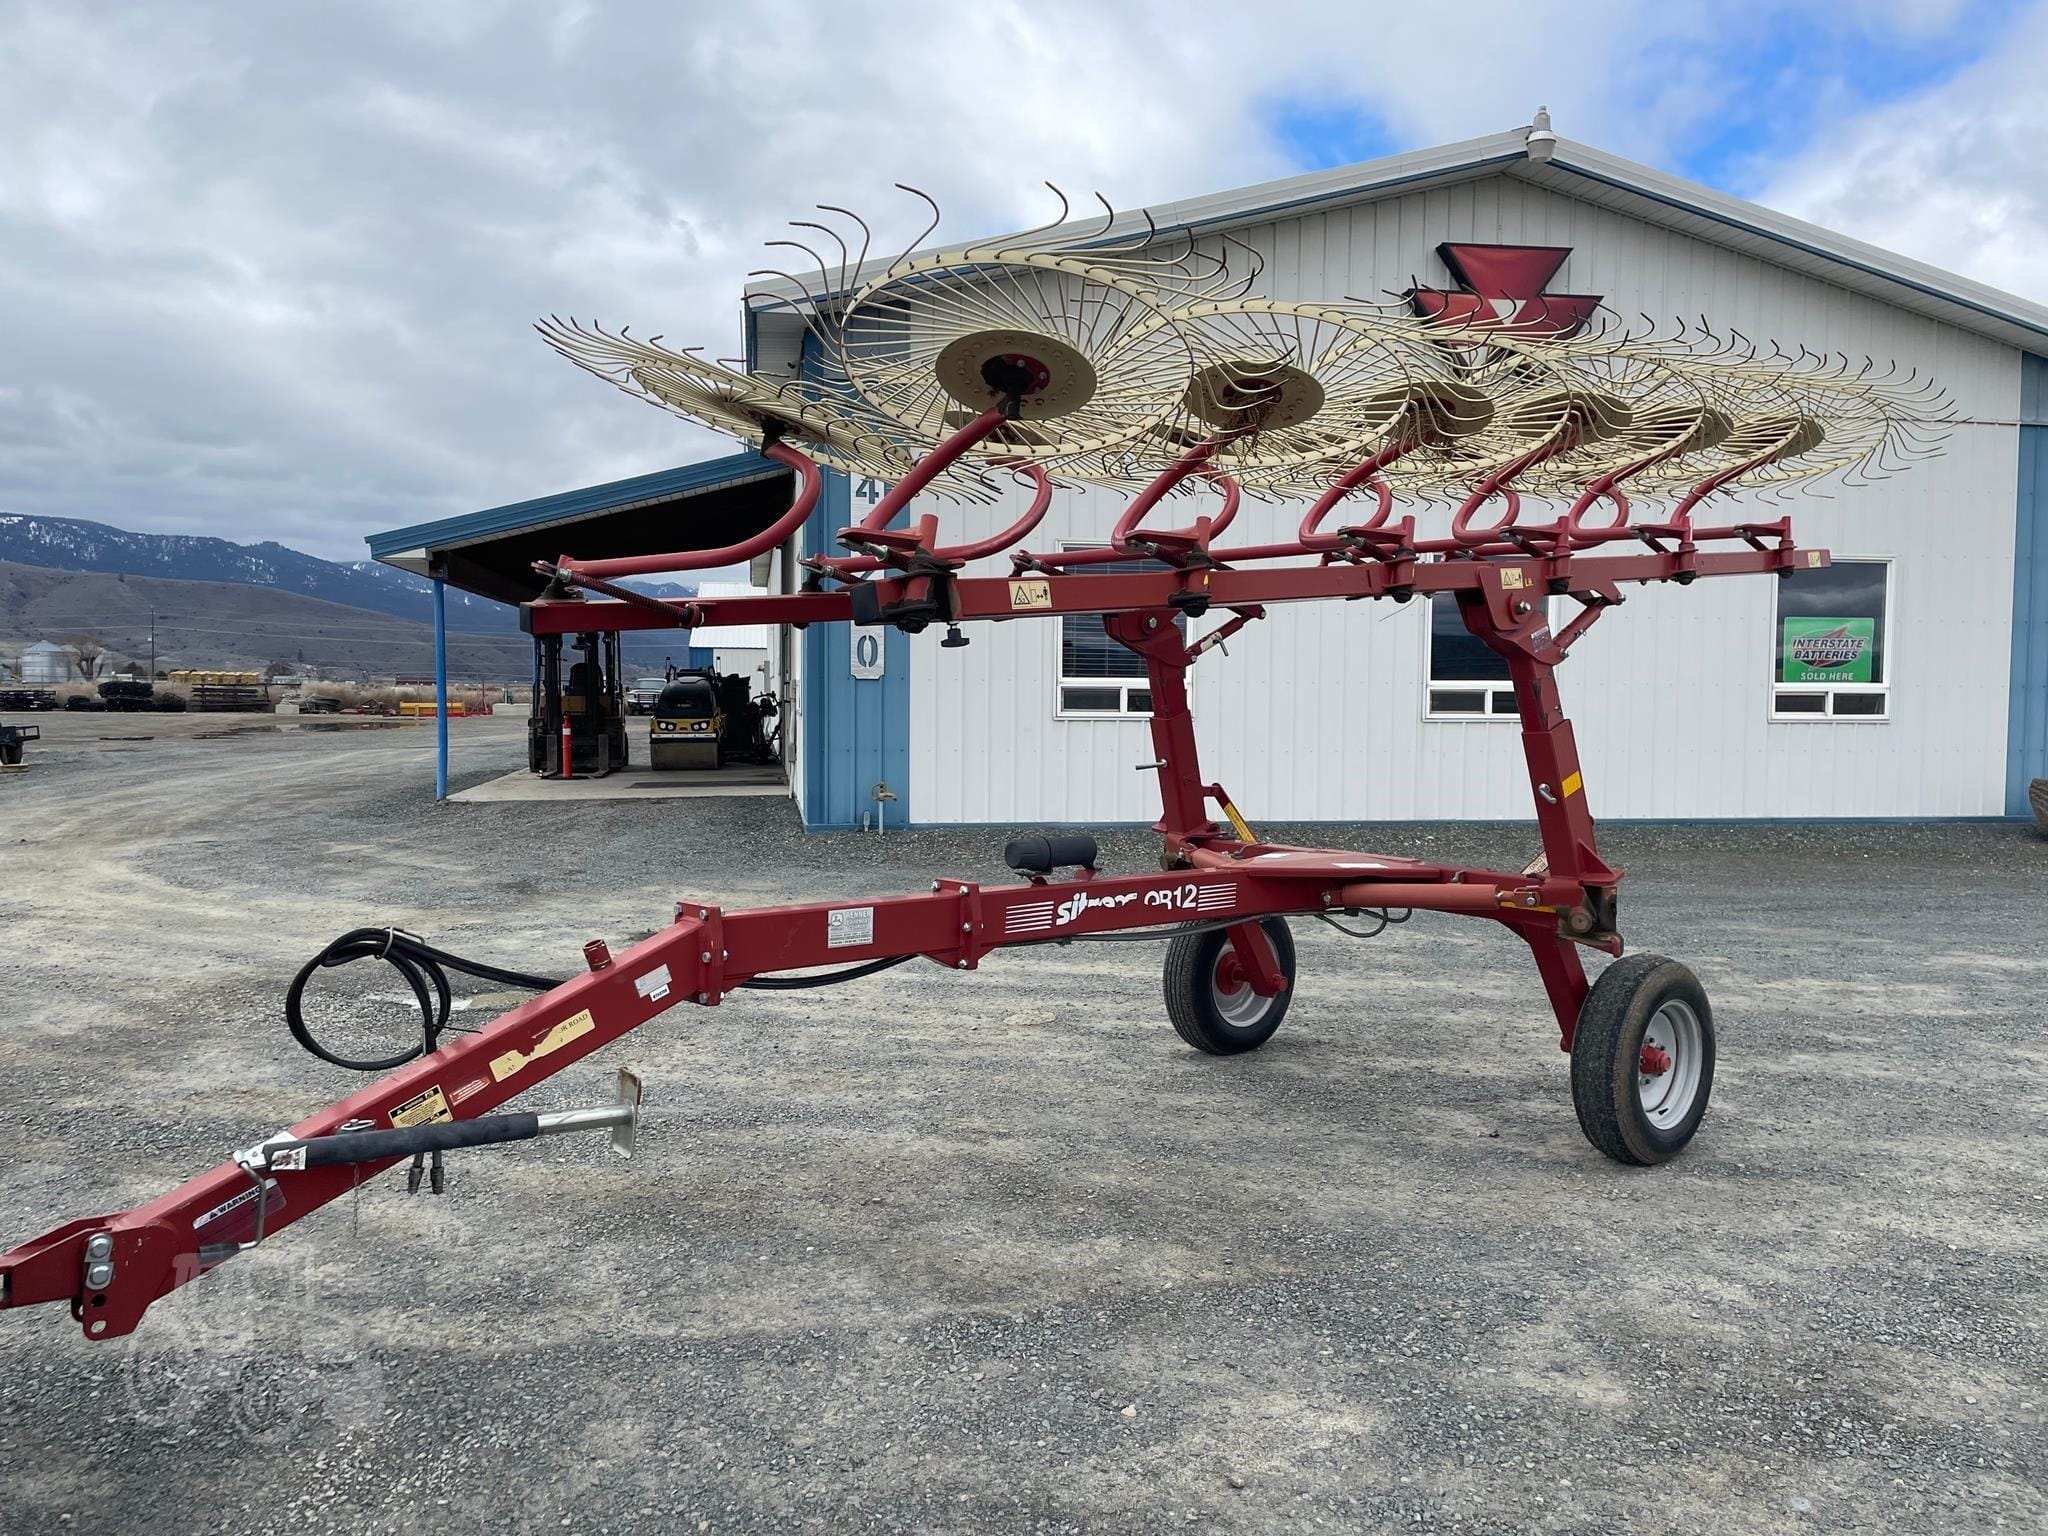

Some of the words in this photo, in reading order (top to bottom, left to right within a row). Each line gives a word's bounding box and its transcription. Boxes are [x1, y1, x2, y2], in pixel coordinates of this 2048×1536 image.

[1792, 639, 1865, 648] INTERSTATE
[1794, 650, 1858, 660] BATTERIES
[1800, 672, 1826, 680] SOLD
[1829, 672, 1854, 681] HERE
[568, 1013, 588, 1029] ROAD
[218, 1186, 262, 1214] WARNING
